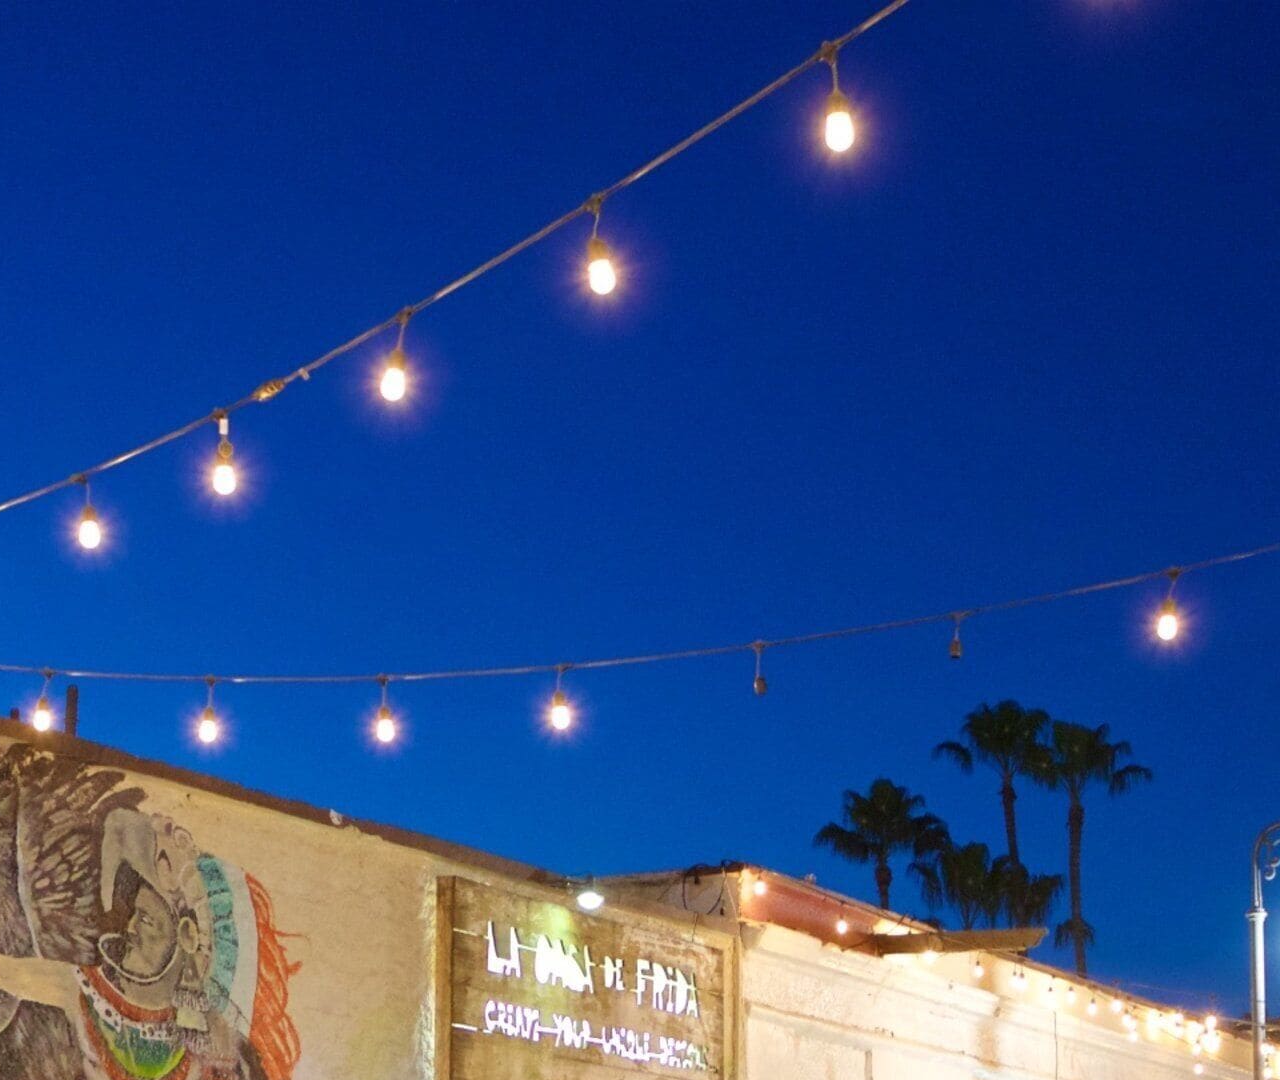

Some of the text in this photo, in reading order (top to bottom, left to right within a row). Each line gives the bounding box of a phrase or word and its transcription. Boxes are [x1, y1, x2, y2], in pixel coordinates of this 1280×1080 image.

[487, 920, 521, 979] LA
[534, 933, 594, 995] CASA
[604, 955, 625, 991] DE
